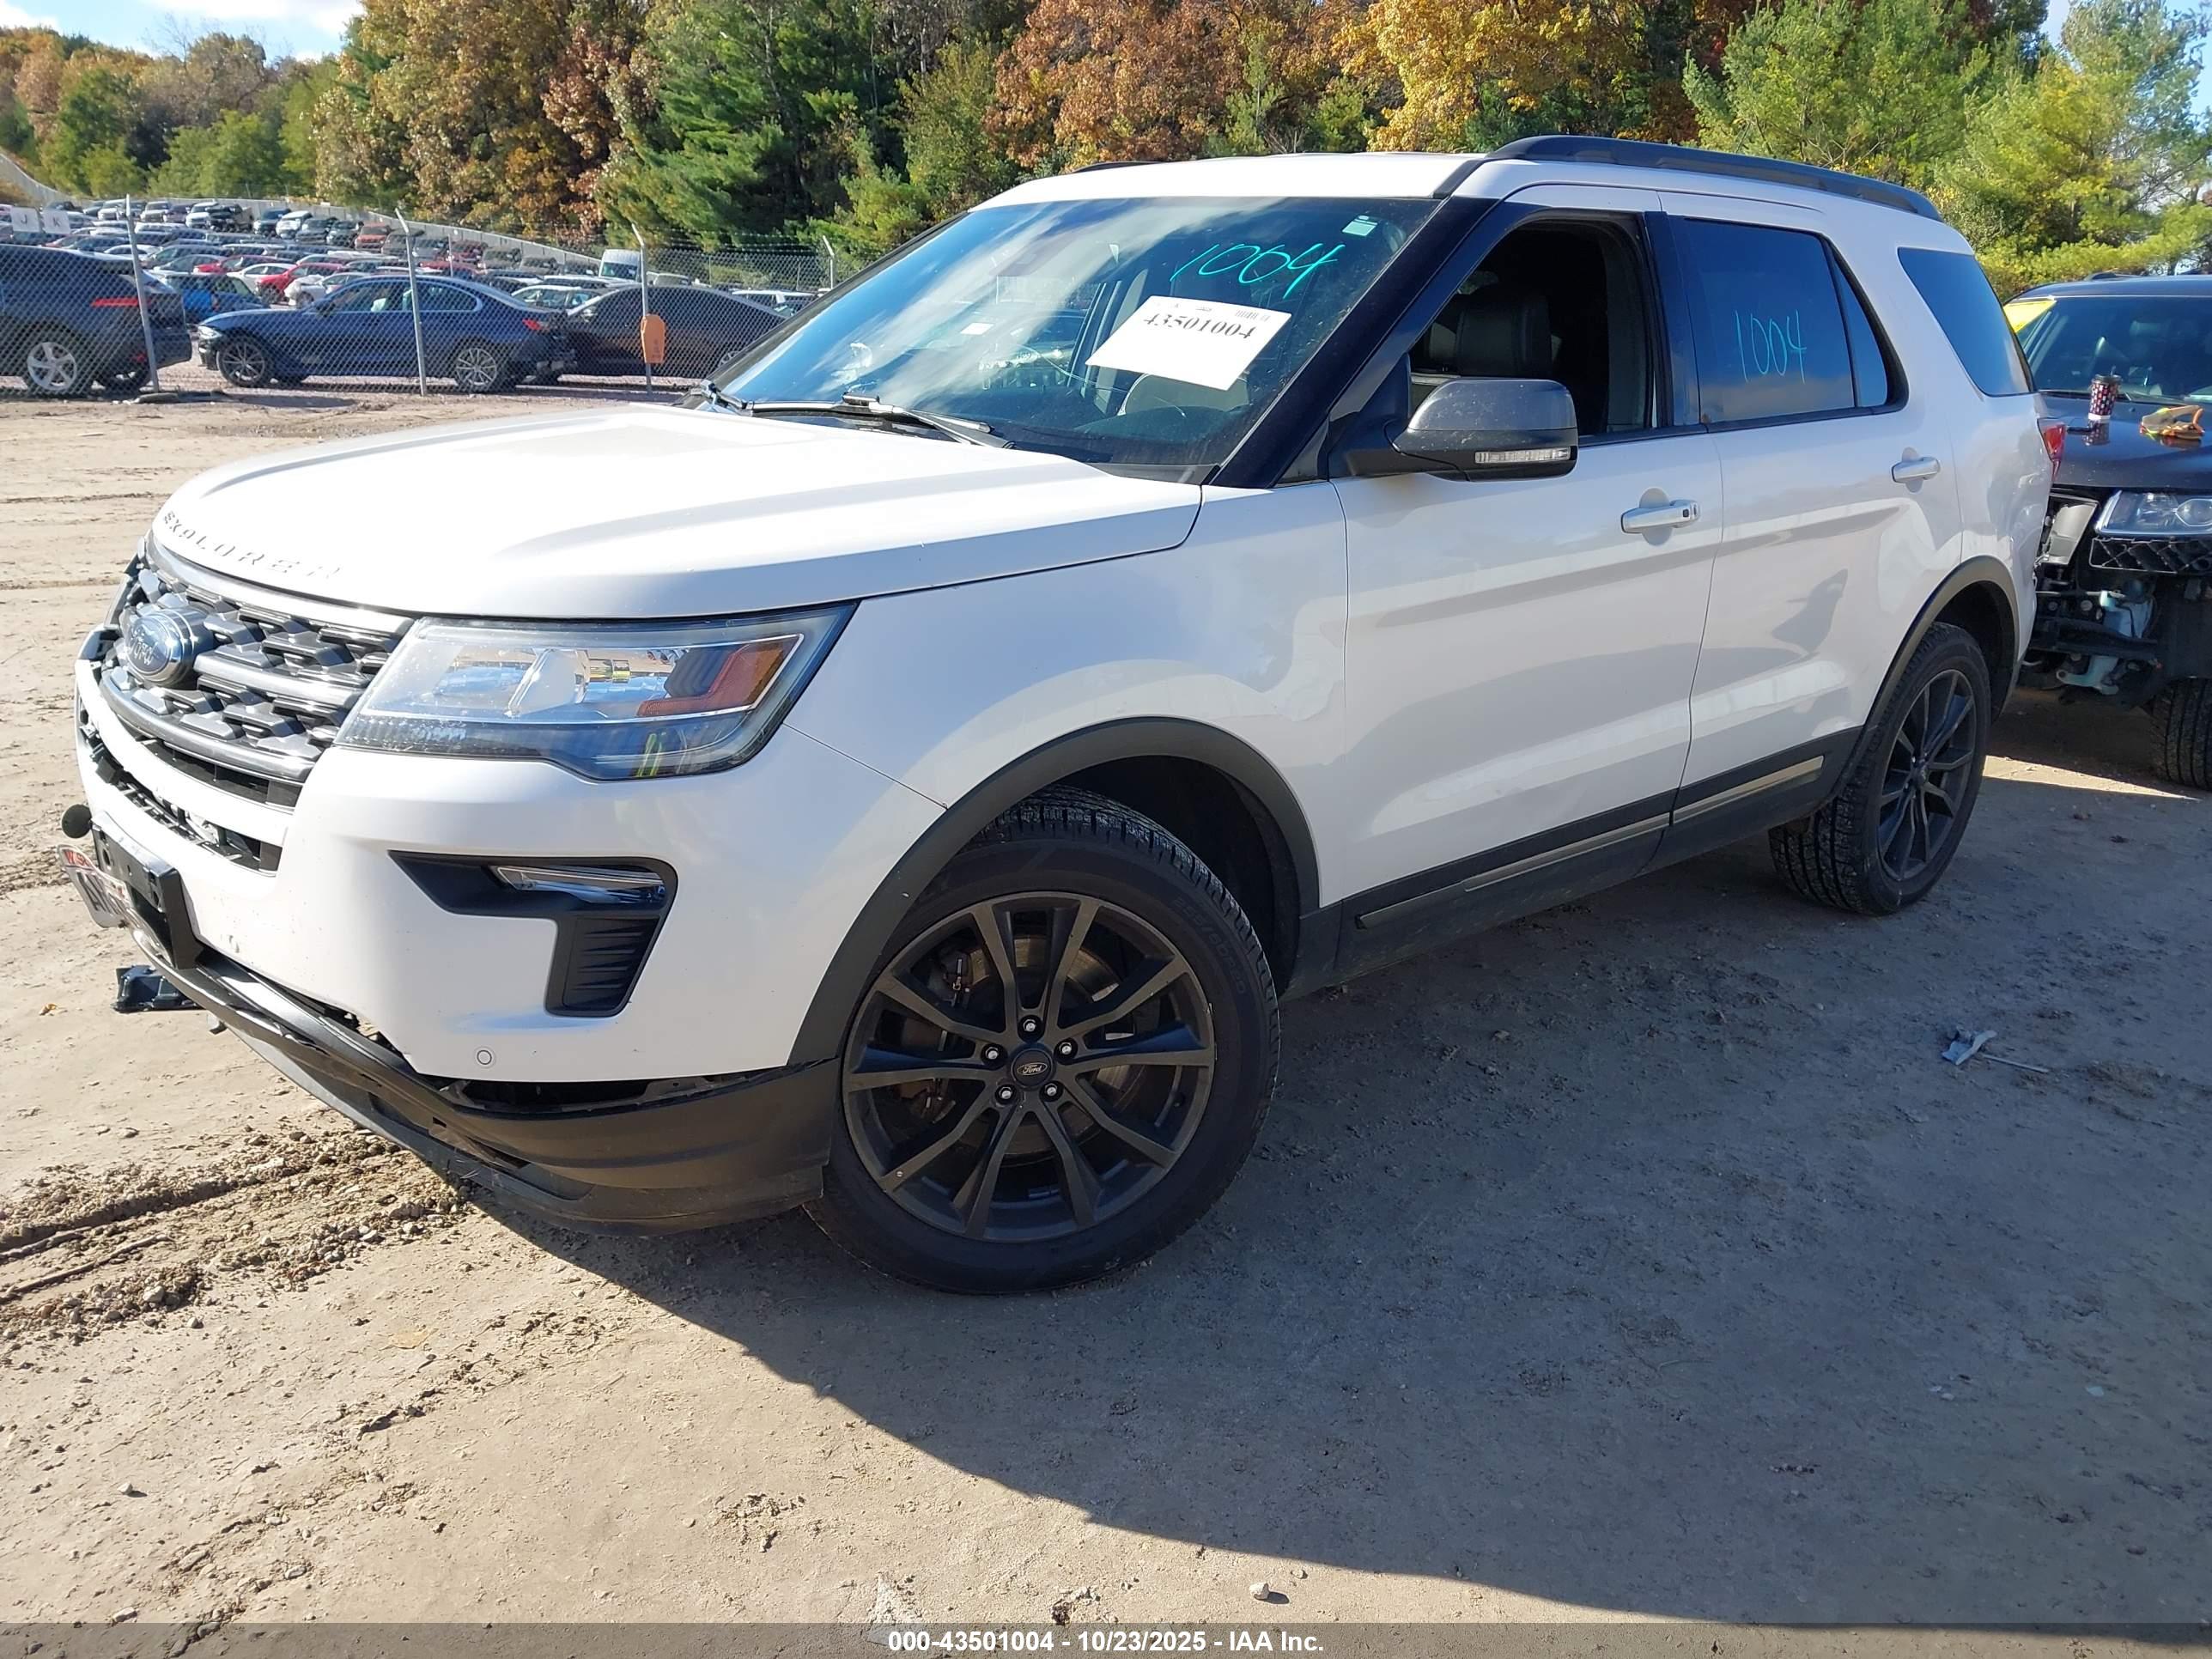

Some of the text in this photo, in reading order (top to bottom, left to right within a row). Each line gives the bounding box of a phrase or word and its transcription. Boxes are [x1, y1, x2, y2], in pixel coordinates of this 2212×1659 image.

[1169, 243, 1346, 299] 1004
[1143, 313, 1256, 339] 43501004
[1735, 309, 1807, 384] 1004
